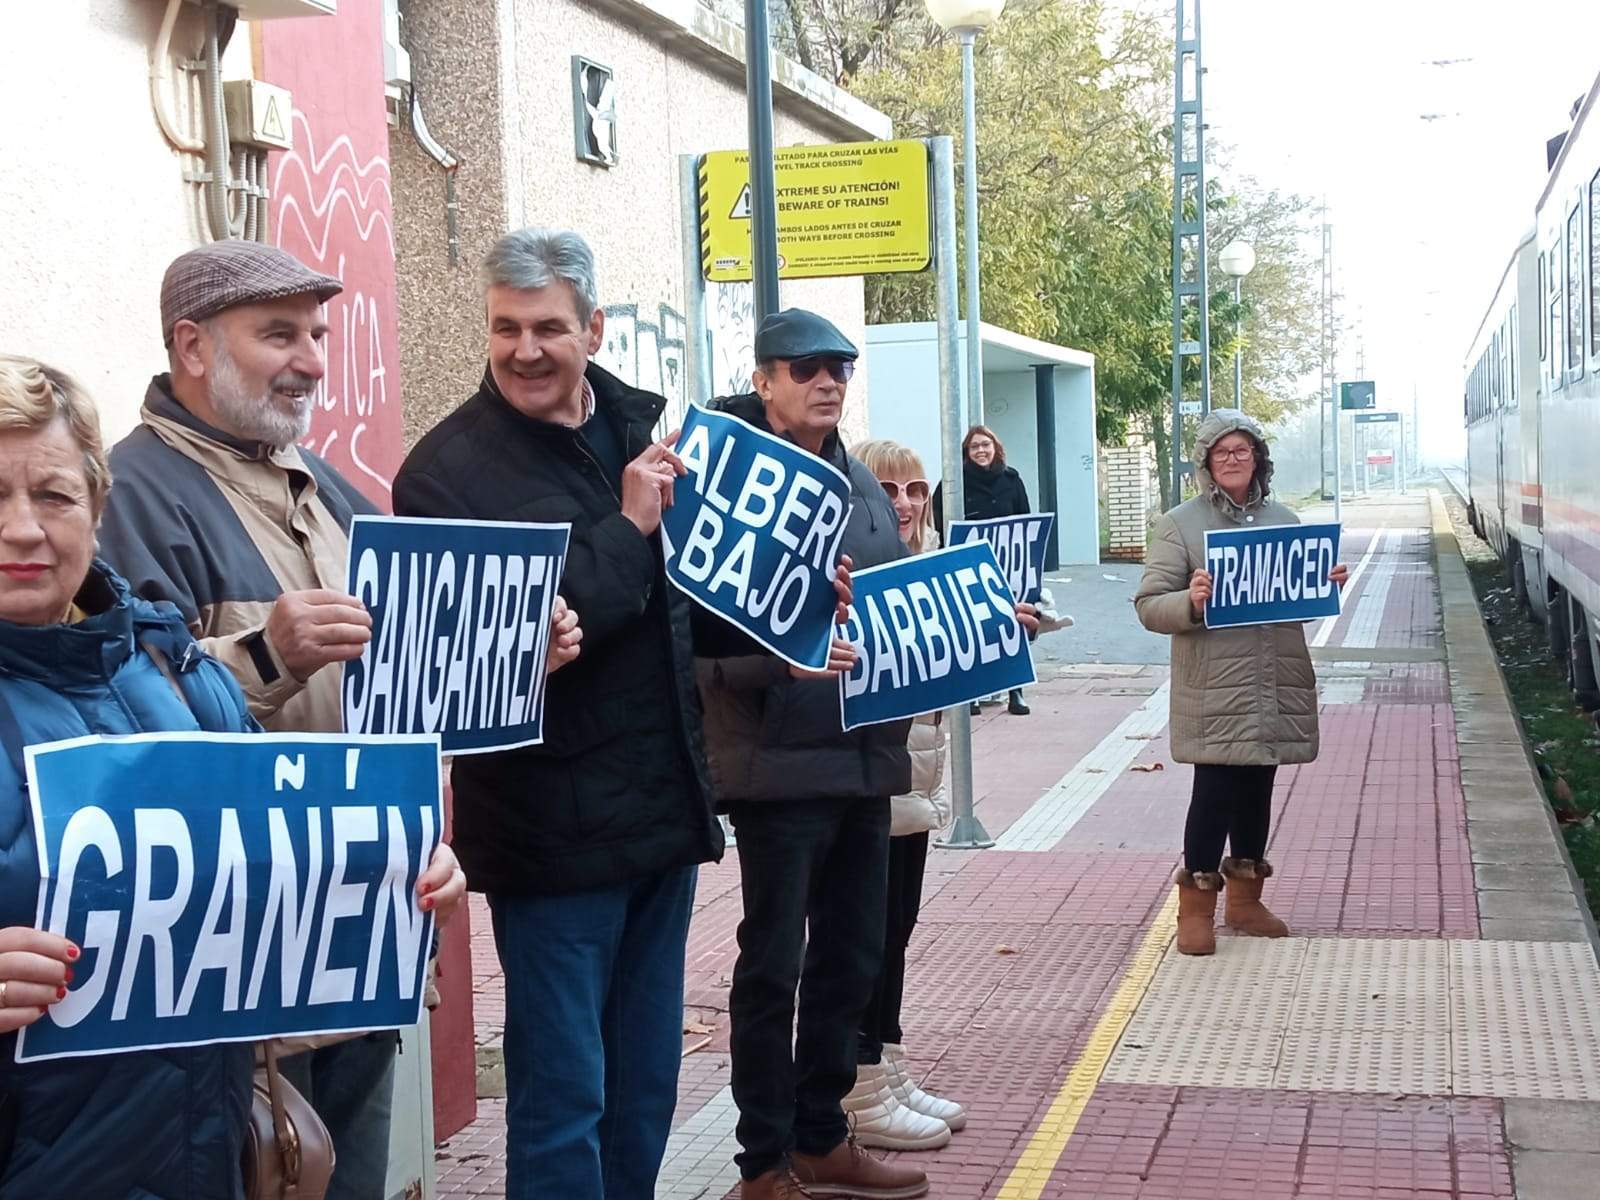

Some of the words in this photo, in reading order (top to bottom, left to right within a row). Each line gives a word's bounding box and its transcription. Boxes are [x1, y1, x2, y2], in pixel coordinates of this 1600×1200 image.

[807, 151, 829, 159] PARA
[829, 149, 861, 157] CRUZAR
[862, 147, 878, 155] LAS
[879, 146, 899, 154] VÍAS
[775, 163, 794, 171] EVEL
[822, 159, 863, 168] CROSSING
[777, 186, 819, 197] XTREME
[822, 185, 837, 194] SU
[839, 181, 900, 194] ATENCIÓN!
[778, 200, 824, 211] BEWARE
[827, 199, 841, 209] OF
[844, 197, 889, 207] TRAINS!
[804, 224, 830, 232] LADOS
[831, 222, 856, 230] ANTES
[858, 221, 869, 229] DE
[870, 220, 902, 228] CRUZAR
[798, 234, 822, 242] WAYS
[854, 231, 895, 239] CROSSING
[1366, 393, 1376, 407] 1
[678, 504, 812, 636] BAJO
[1209, 537, 1334, 608] TRAMACED
[840, 562, 1021, 698] BARBUES
[346, 547, 563, 733] SANGARREN
[48, 748, 434, 1028] GRAÑÉN
